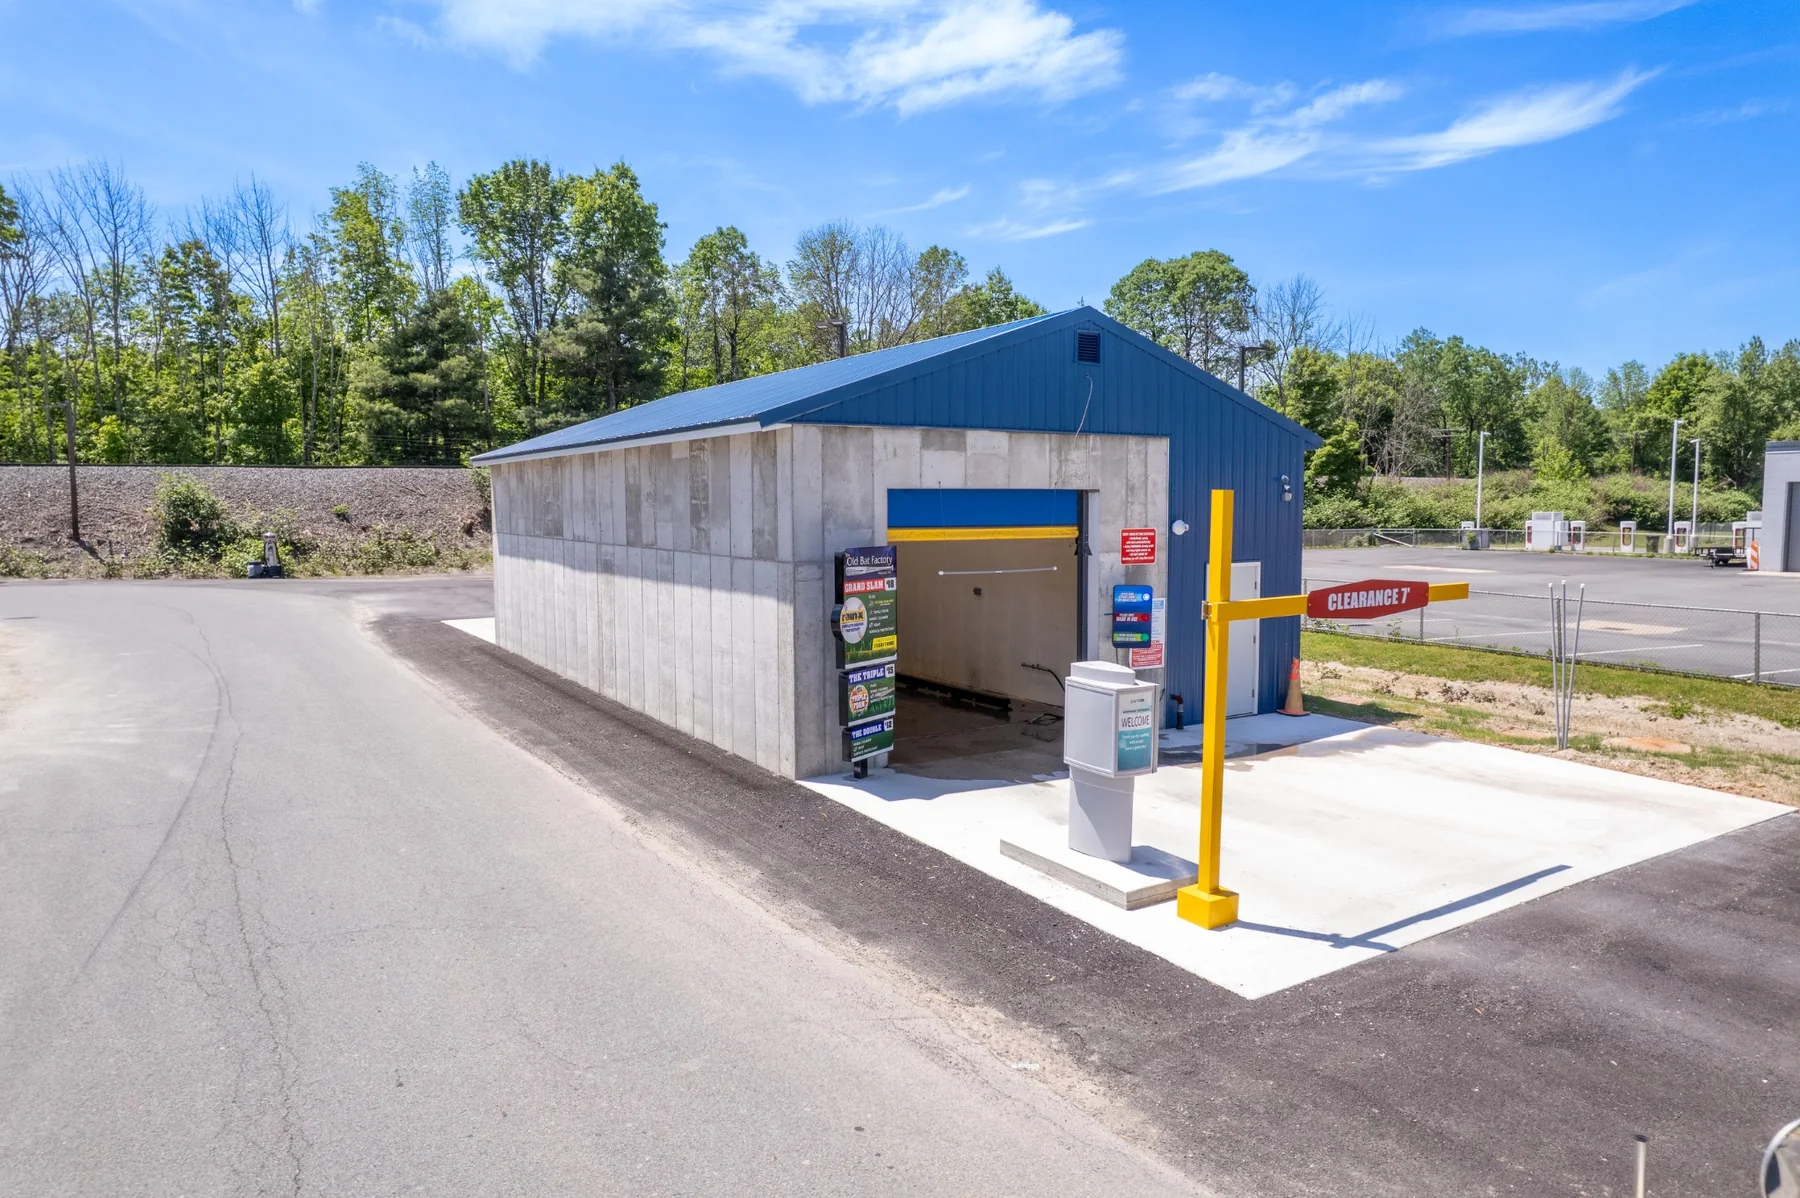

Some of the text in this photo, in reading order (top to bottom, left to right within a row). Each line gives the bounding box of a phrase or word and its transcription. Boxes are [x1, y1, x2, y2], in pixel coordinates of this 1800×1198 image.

[847, 555, 893, 566] Old Bat Factory
[845, 582, 866, 593] GRAND
[867, 580, 884, 591] SLAM
[1328, 587, 1411, 612] CLEARANCE 7'
[849, 672, 862, 683] THE
[863, 668, 884, 680] TRIPLE
[1122, 714, 1150, 728] WELCOME
[852, 729, 863, 739] THE
[863, 724, 882, 736] DOUBLE
